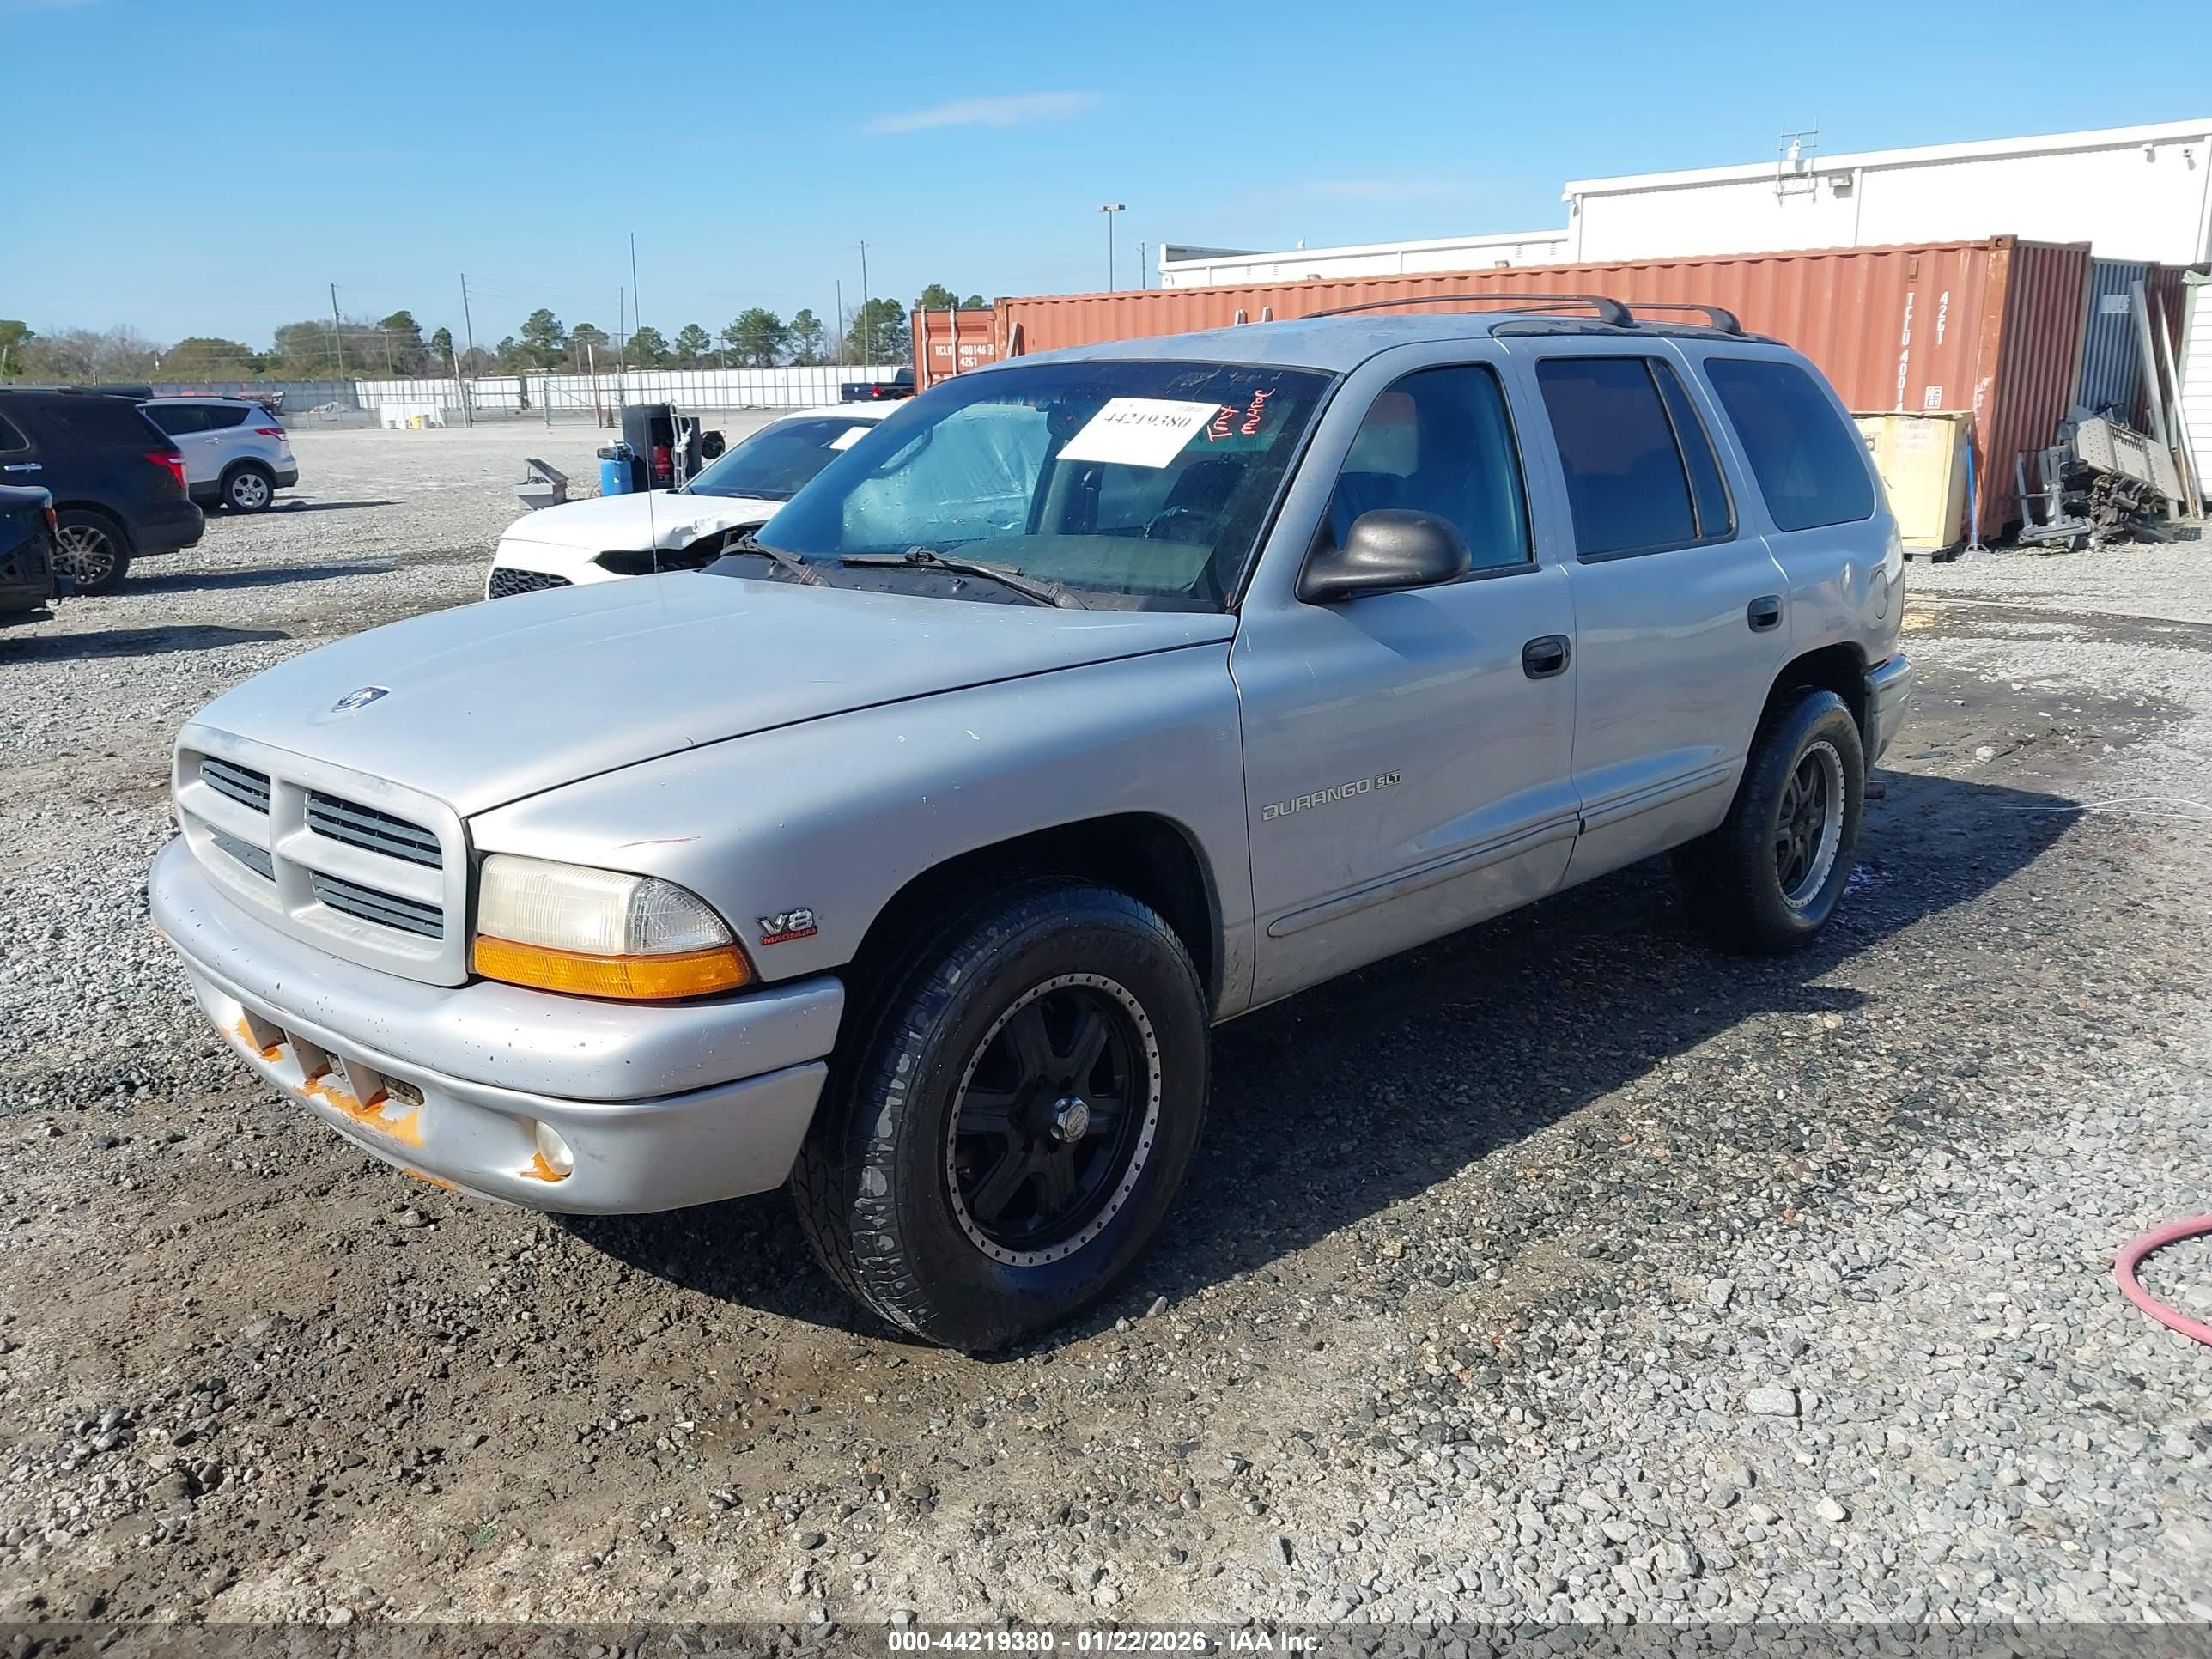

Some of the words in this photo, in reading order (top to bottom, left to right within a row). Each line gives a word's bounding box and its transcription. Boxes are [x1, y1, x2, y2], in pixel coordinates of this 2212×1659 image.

[1902, 292, 1916, 346] TCLU
[1937, 291, 1949, 345] 42G1
[960, 345, 987, 356] 400146
[1104, 412, 1192, 428] 44219380
[1262, 778, 1370, 821] DURANGO
[1376, 772, 1401, 787] SLT
[756, 908, 813, 935] V8
[763, 928, 816, 945] MAGNUM
